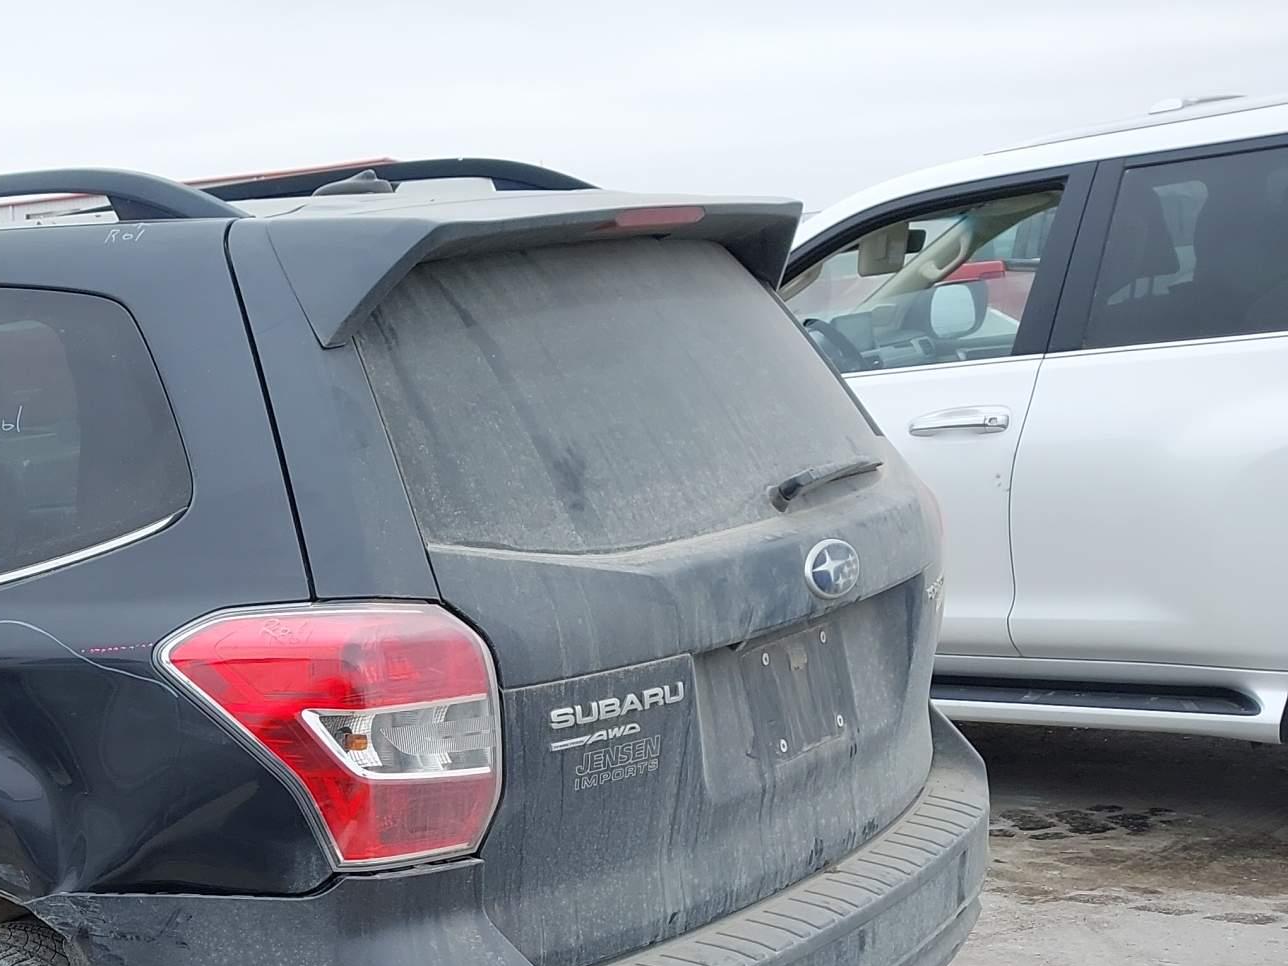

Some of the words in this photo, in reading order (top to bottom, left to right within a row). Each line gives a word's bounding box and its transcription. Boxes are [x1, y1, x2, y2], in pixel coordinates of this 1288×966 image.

[549, 681, 685, 730] SUBARU
[586, 723, 642, 745] AWD
[575, 735, 661, 775] JENSEN
[573, 758, 659, 791] IMPORTS
